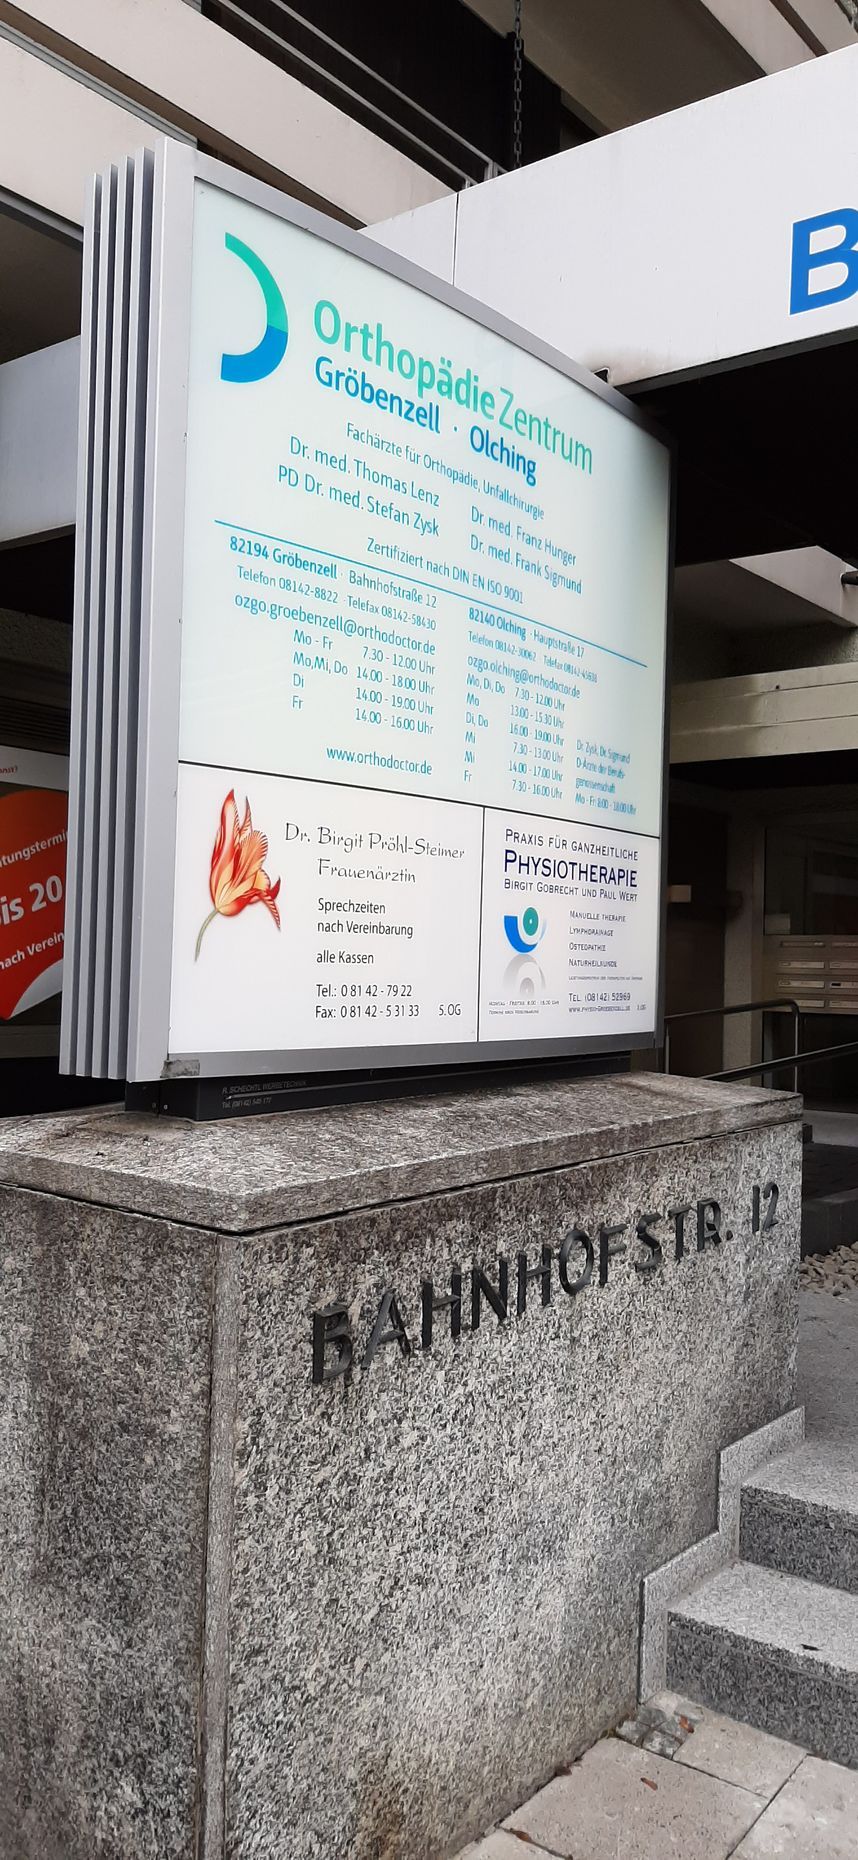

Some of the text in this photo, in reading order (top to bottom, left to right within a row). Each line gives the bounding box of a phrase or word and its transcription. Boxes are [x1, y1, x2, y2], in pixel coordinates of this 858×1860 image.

[790, 208, 858, 315] B
[315, 356, 536, 486] Gröbenzell Olching
[290, 436, 439, 507] Dr. med. Thomas Lenz
[346, 422, 545, 520] Fachärzte für Orthopädie, Unfallchirurgie
[278, 465, 439, 537] PD Dr. med. Stefan Zysk
[471, 505, 576, 566] Dr. med. Franz Hunger
[229, 535, 437, 608] 82194 Gröbenzell Bahnhofstraße 12
[367, 537, 523, 604] Zertifiziert nach DIN EN ISO 9001
[470, 534, 582, 595] Dr. med. Frank Sigmund
[237, 565, 437, 631] Telefon 08142-8822 Telefax 08142-58430
[234, 594, 436, 656] ozgo.groebenzell@orthodoctor.de
[468, 606, 585, 659] 82140 Olching Hauptstraße 17
[468, 630, 494, 648] Telefon
[293, 629, 435, 675] Mo Fr 7.30 12.00 Uhr
[293, 673, 434, 715] Di 14.00 19.00 Uhr
[334, 660, 348, 676] Do
[356, 666, 383, 683] 14.00
[391, 674, 416, 691] 18.00
[418, 679, 435, 695] Uhr
[466, 672, 482, 690] Mo,
[495, 680, 506, 695] Do
[514, 686, 530, 701] 7.30
[535, 692, 553, 708] 12.00
[553, 698, 565, 712] Uhr
[292, 695, 434, 735] Fr 14.00 16.00 Uhr
[466, 692, 480, 707] Mo
[510, 704, 529, 720] 13.00
[553, 715, 564, 729] Uhr
[477, 714, 489, 728] Do
[552, 732, 564, 746] Uhr
[326, 747, 433, 775] www.orthodoctor.de
[464, 750, 475, 764] Mi
[551, 768, 563, 782] Uhr
[465, 731, 476, 744] Mi
[551, 750, 564, 763] Uhr
[464, 770, 472, 783] Fr
[550, 786, 563, 799] Uhr
[285, 822, 311, 843] Dr.
[317, 826, 364, 853] Birgit
[505, 828, 544, 847] PRAXIS
[317, 858, 416, 883] Frauenärztin
[504, 849, 638, 888] PHYSIOTHERAPIE
[0, 875, 63, 925] is 20
[318, 897, 386, 914] Sprechzeiten
[317, 920, 414, 939] nach Vereinbarung
[316, 949, 374, 964] alle Kassen
[316, 984, 337, 997] Tel.:
[315, 1005, 336, 1019] Fax:
[752, 1182, 780, 1234] 12
